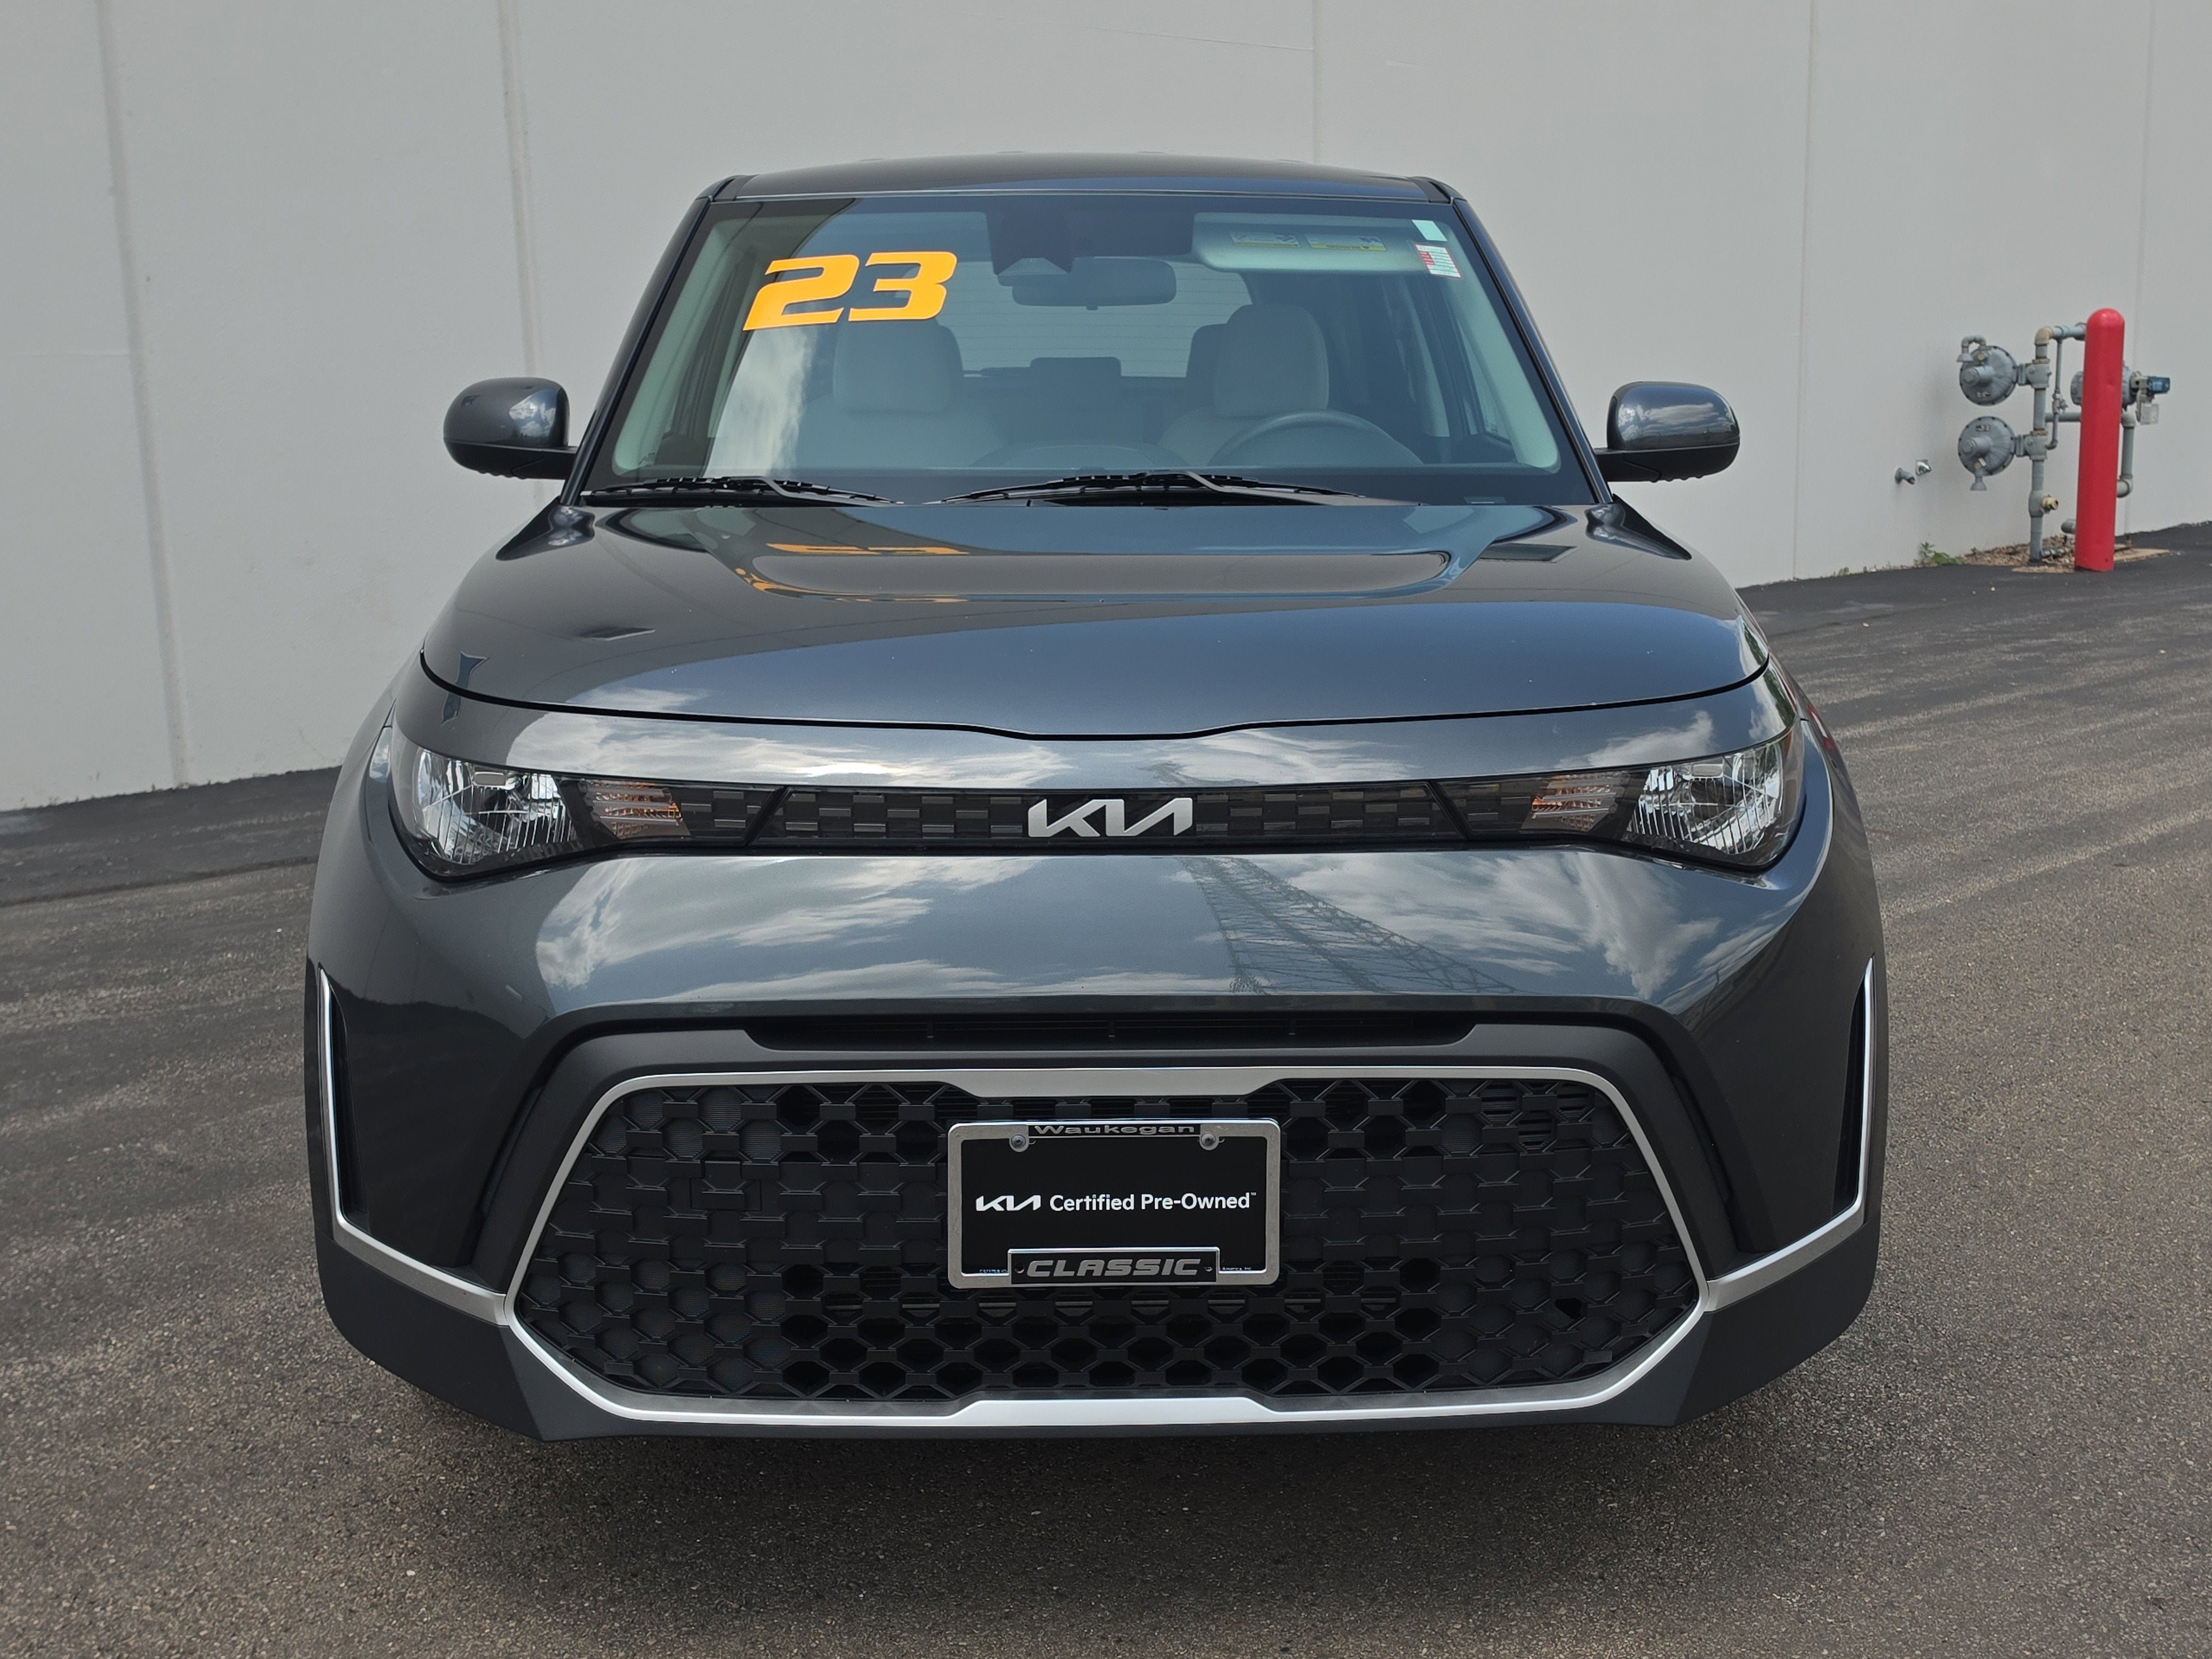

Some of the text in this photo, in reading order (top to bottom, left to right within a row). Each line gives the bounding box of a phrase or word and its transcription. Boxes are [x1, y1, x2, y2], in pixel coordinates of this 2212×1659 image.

[743, 252, 957, 331] 23
[1028, 798, 1193, 837] KIA
[1034, 1125, 1194, 1135] Waukegan
[975, 1192, 1250, 1211] KIA Certified Pre-Owned
[1027, 1259, 1201, 1277] CLASSIC
